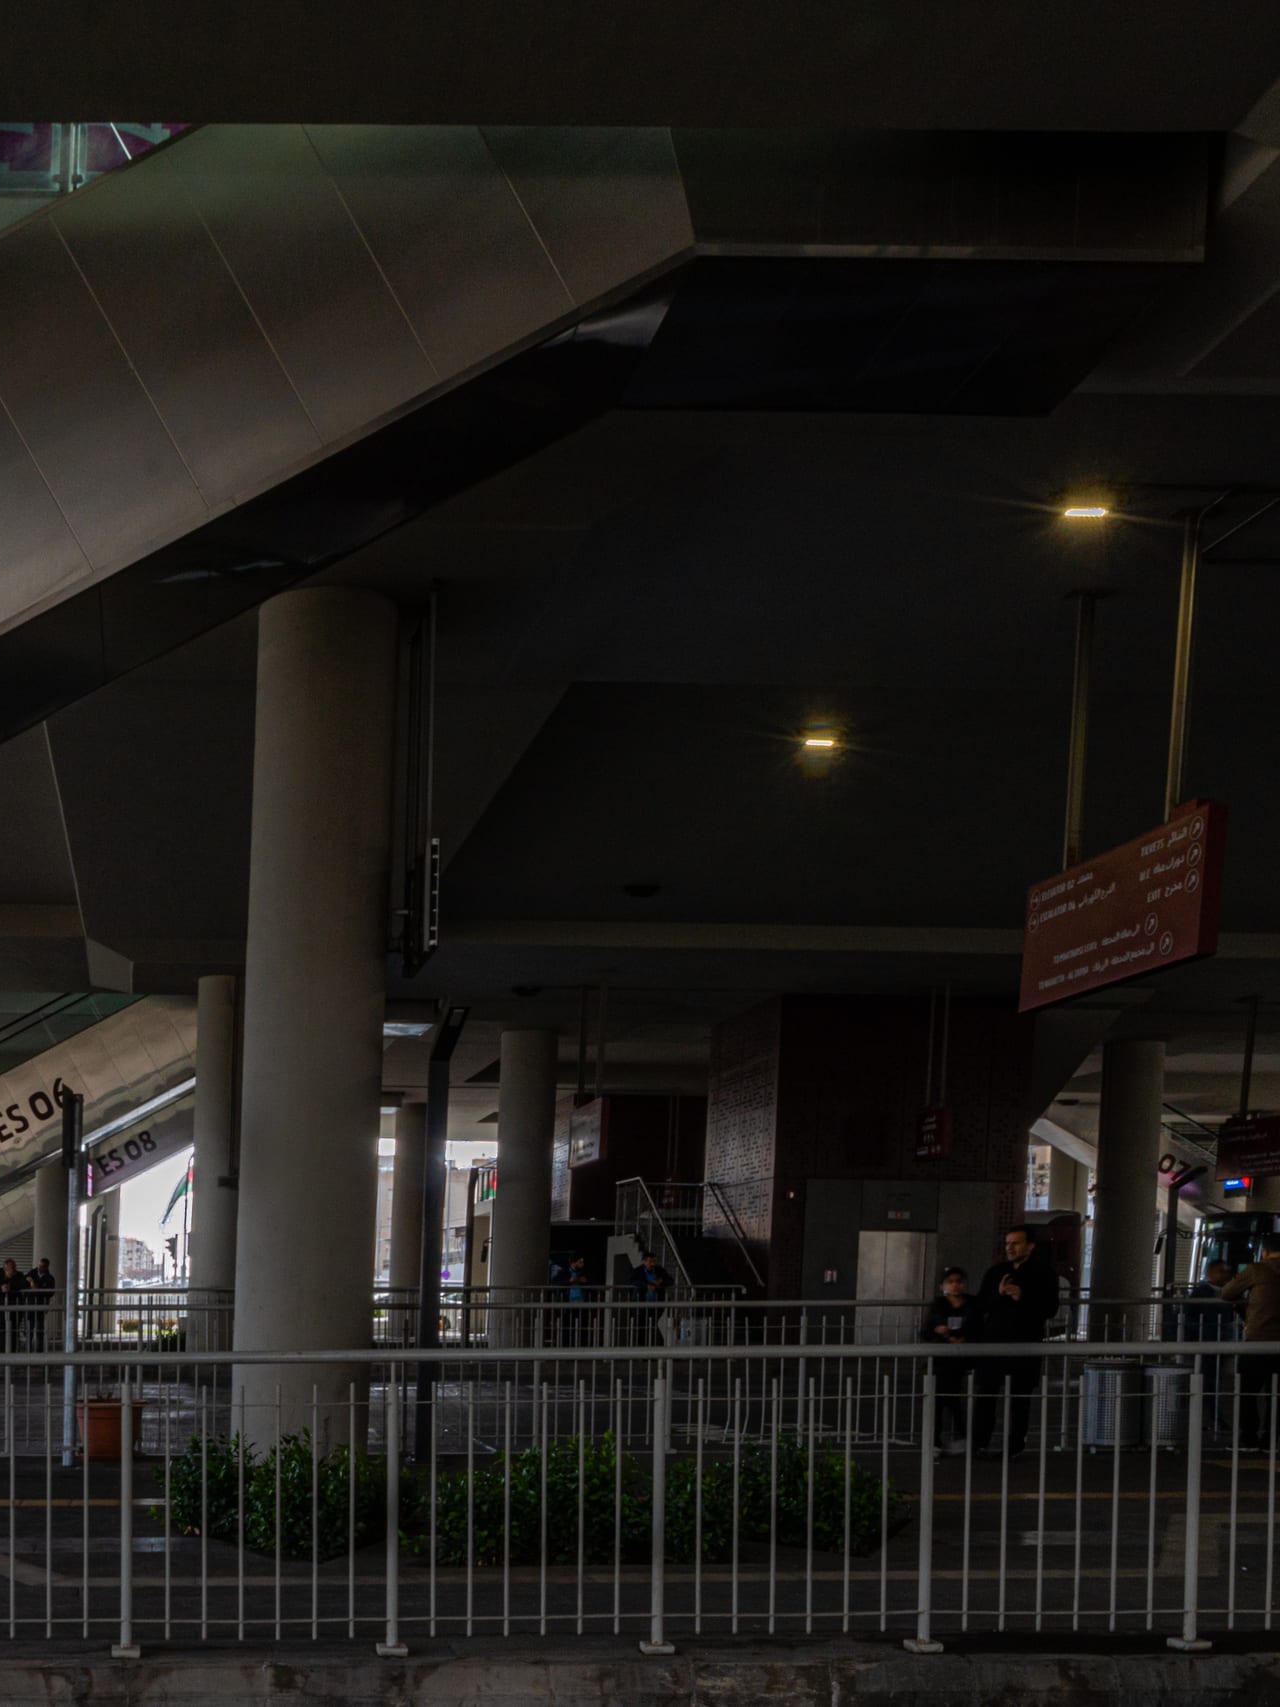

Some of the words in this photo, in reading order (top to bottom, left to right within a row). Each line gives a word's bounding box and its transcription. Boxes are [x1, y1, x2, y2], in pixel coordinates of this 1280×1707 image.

[1147, 888, 1161, 903] EXIT
[96, 1146, 124, 1176] ES
[123, 1130, 157, 1161] 08
[1158, 1153, 1191, 1182] 07
